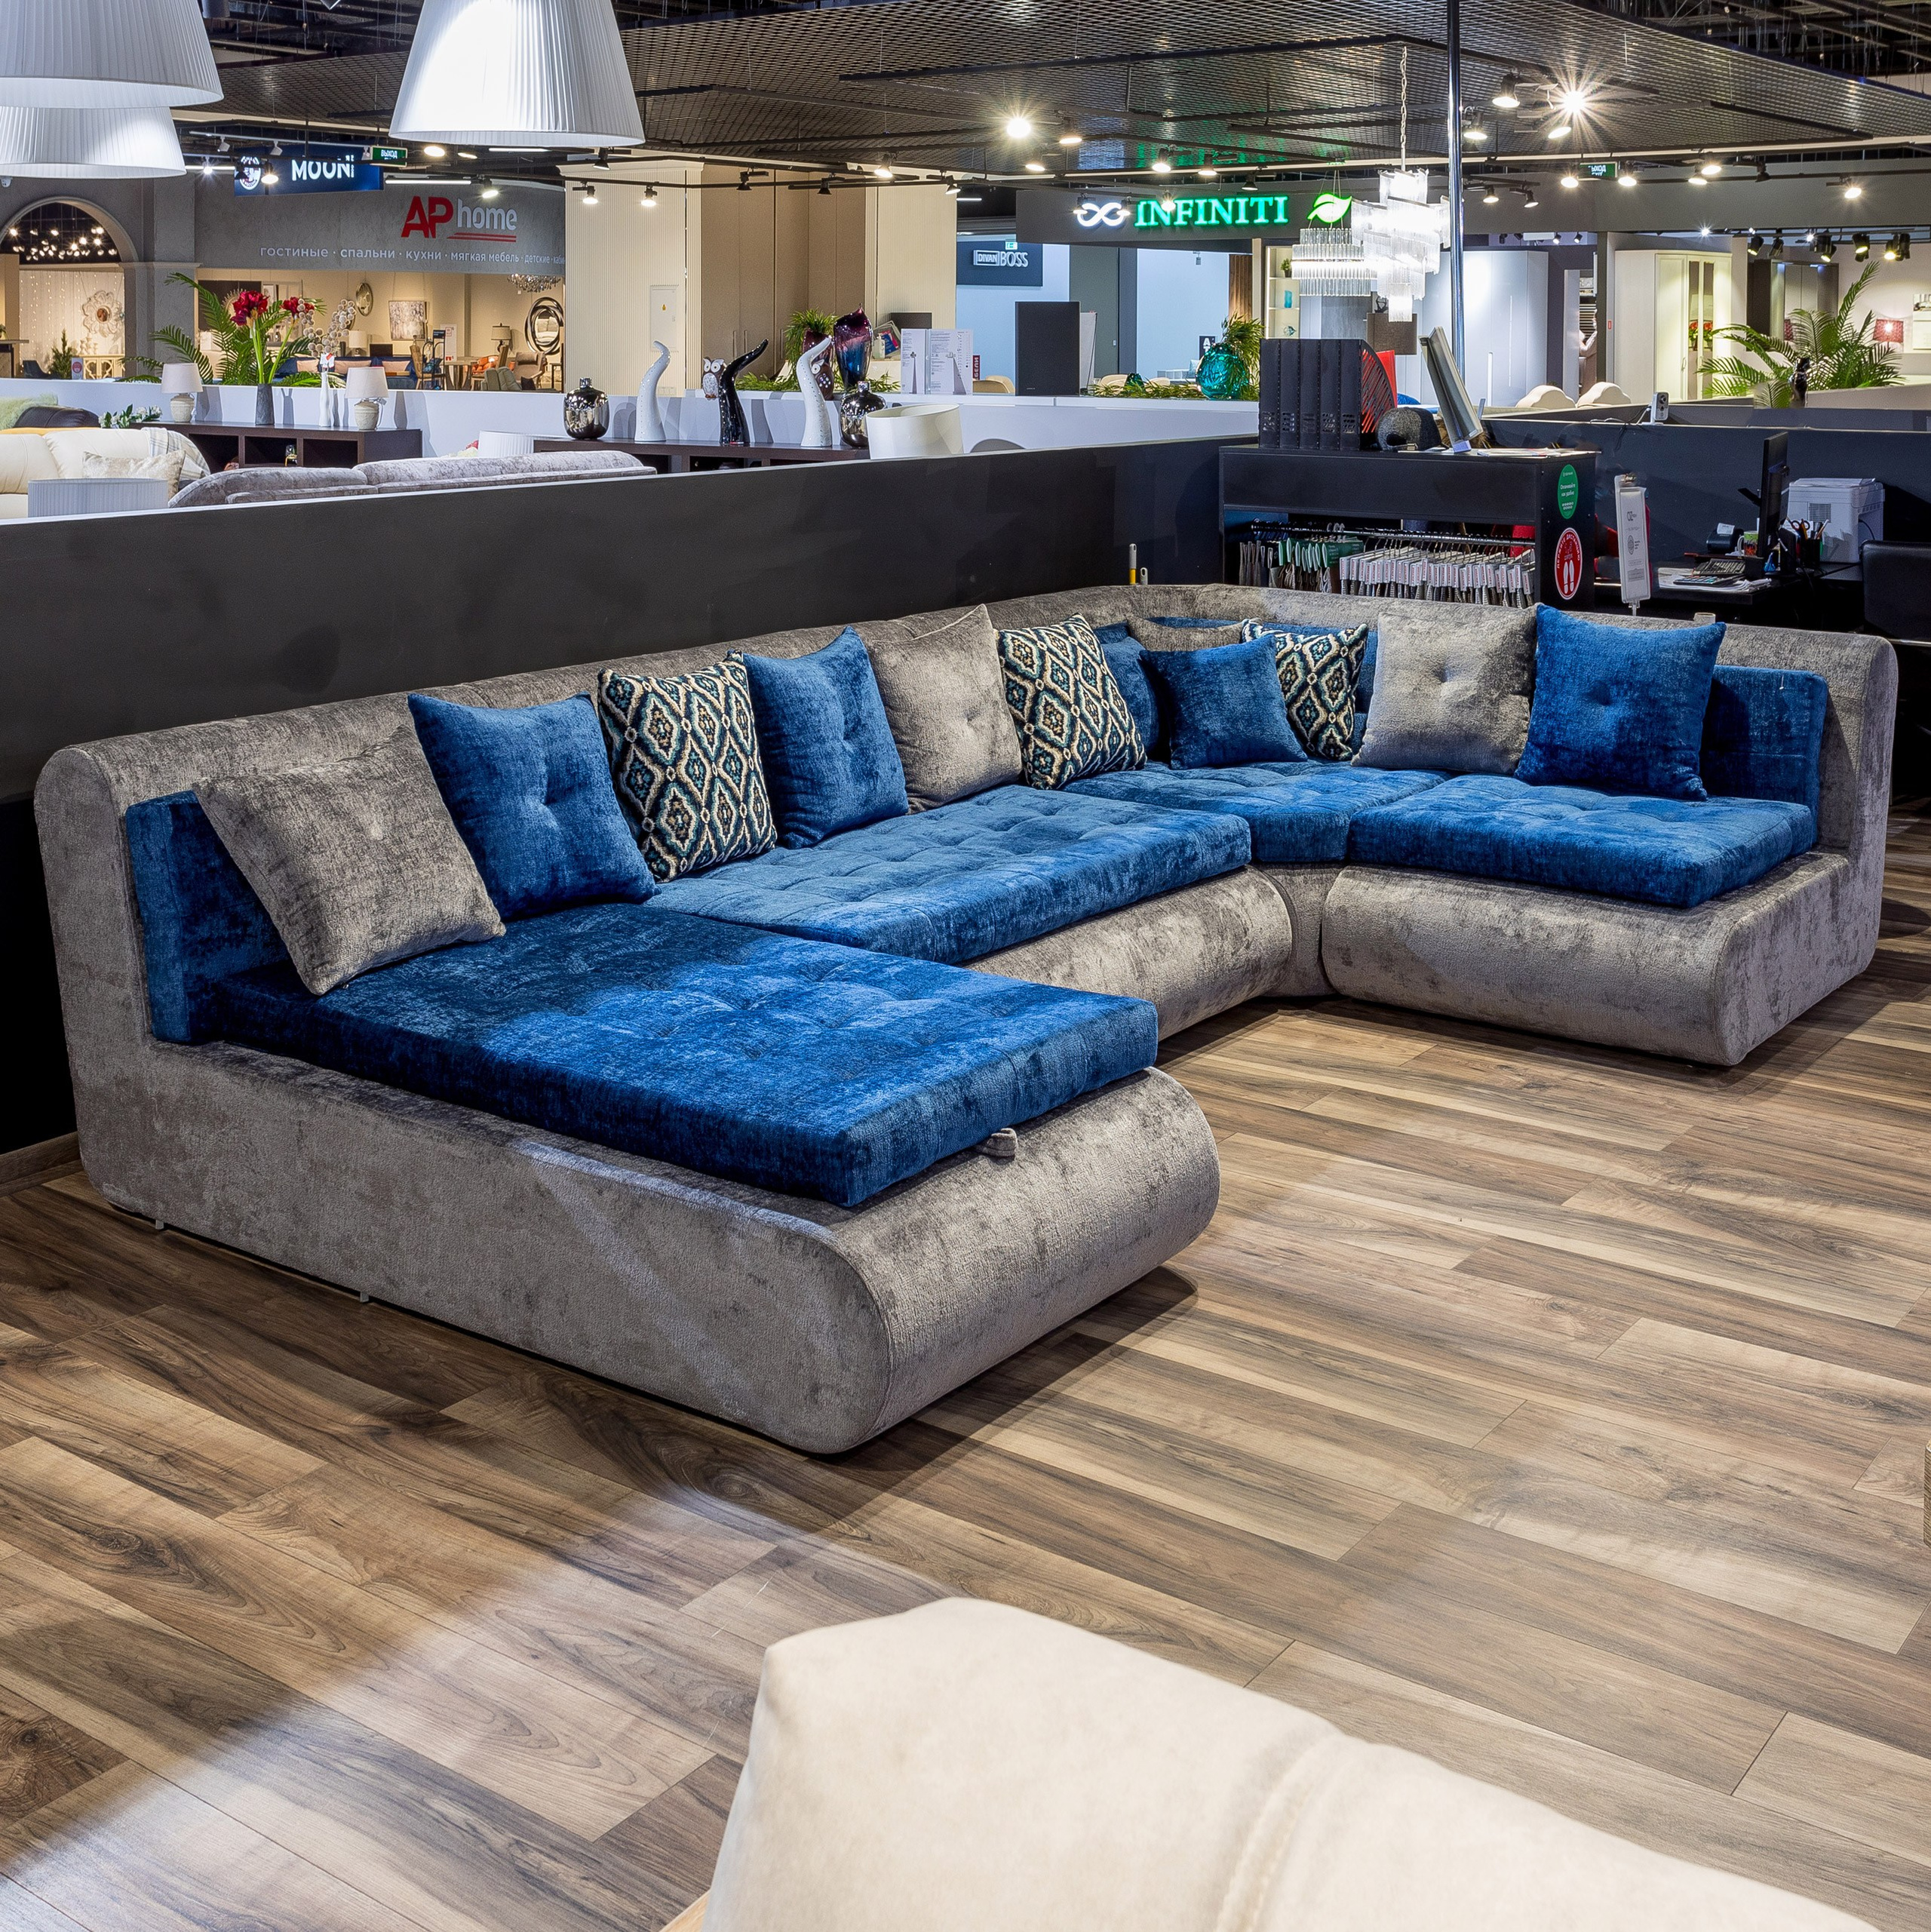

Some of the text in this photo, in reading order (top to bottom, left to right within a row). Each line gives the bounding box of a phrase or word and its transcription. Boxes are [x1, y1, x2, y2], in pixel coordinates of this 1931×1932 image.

[381, 149, 398, 159] ВЫХОД
[1588, 164, 1606, 173] ЫХОД
[401, 195, 517, 238] AP home
[1134, 196, 1289, 227] INFINITI
[260, 247, 329, 257] гостиные
[340, 248, 395, 258] спальни
[406, 250, 441, 261] кухни
[450, 252, 486, 262] мягкая
[489, 250, 519, 263] мебель
[524, 254, 550, 265] детские
[978, 251, 1029, 267] DIVAN BOSS
